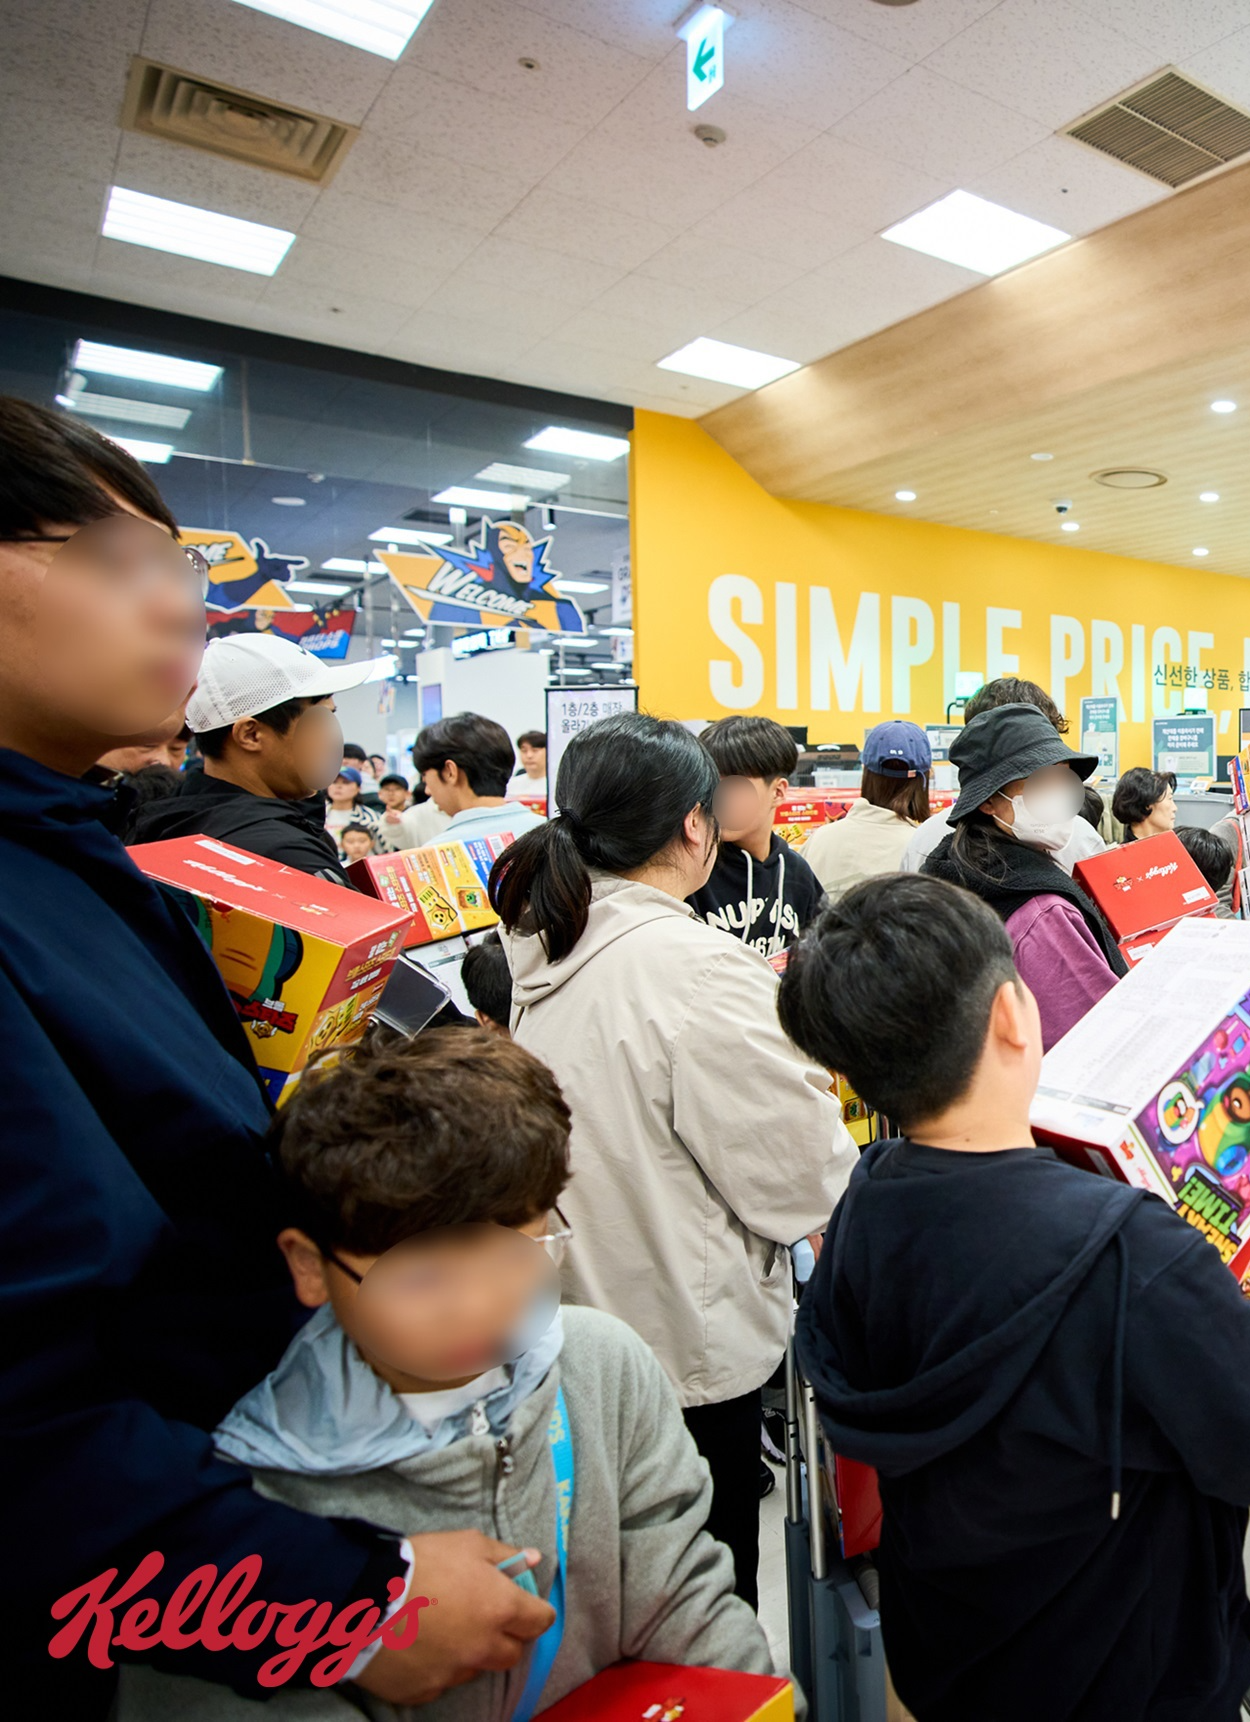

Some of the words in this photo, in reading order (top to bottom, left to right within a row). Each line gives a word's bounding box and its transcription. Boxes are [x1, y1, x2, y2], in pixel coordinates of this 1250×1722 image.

[428, 561, 534, 616] WELCOME
[707, 574, 1022, 716] SIMPLE
[1154, 664, 1197, 686] 신선한
[1203, 669, 1233, 691] 상품,
[563, 702, 599, 716] 1층/2층
[1145, 862, 1178, 880] Kellogg's
[1178, 1176, 1239, 1234] TIME!
